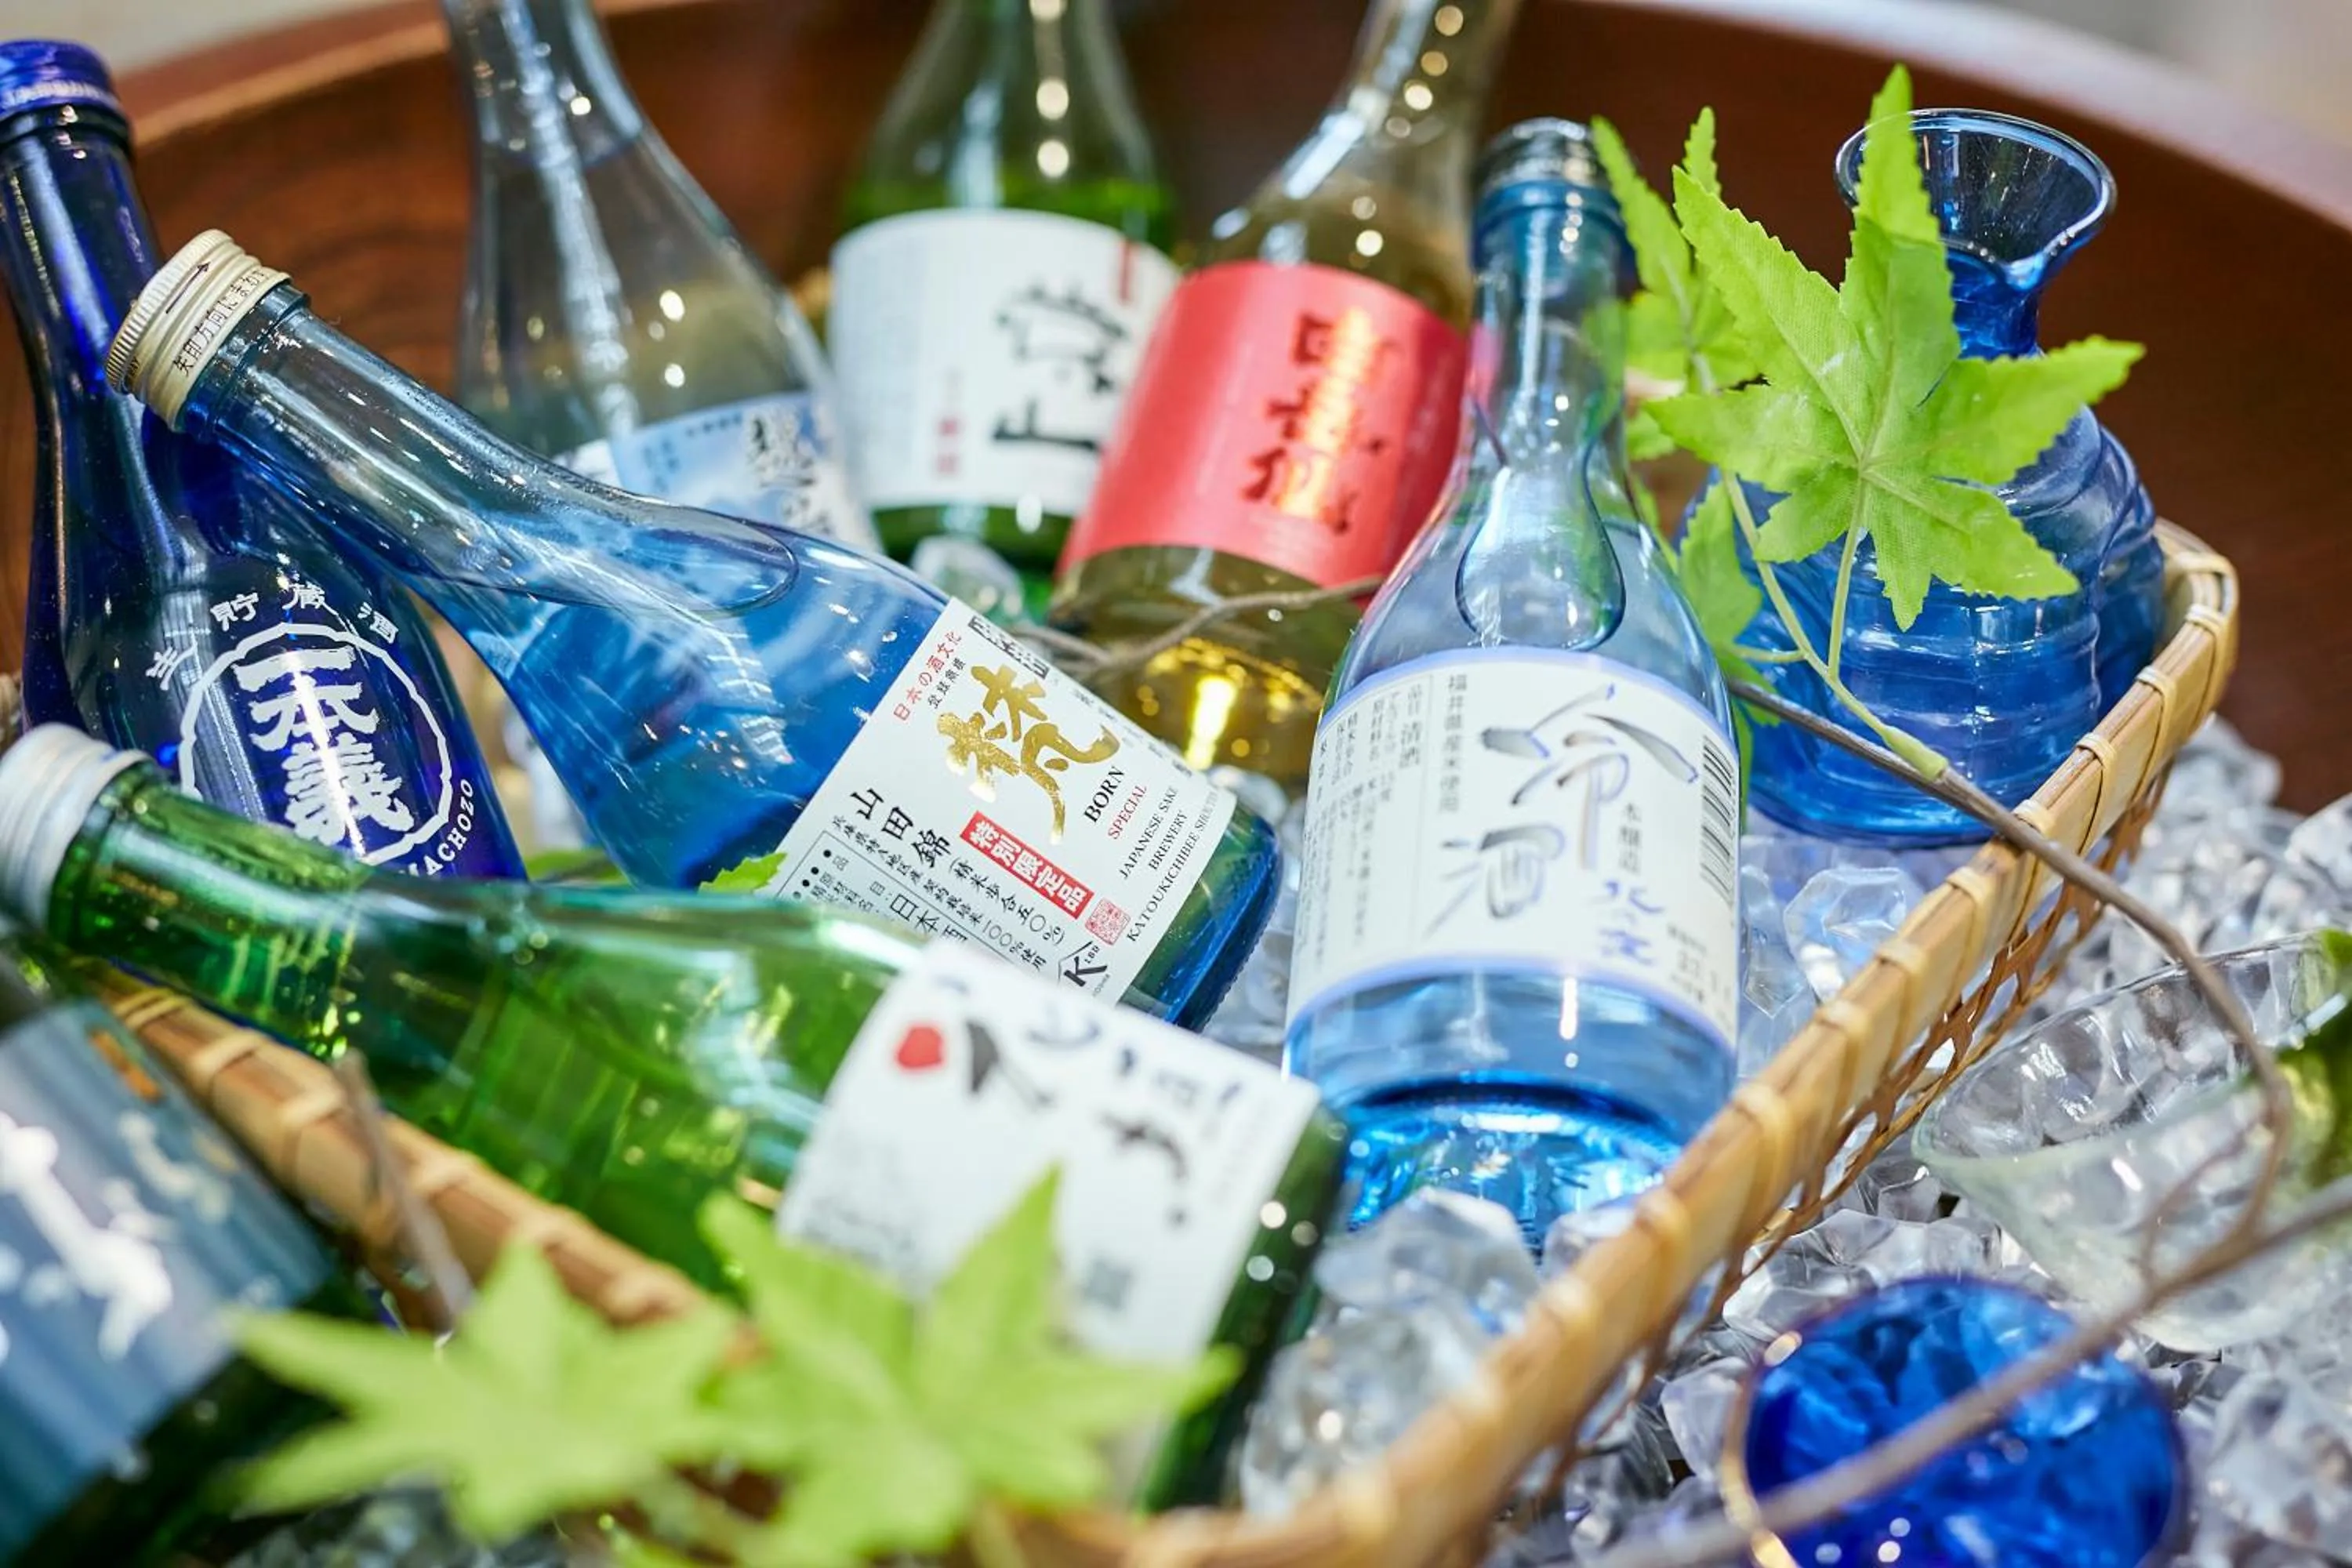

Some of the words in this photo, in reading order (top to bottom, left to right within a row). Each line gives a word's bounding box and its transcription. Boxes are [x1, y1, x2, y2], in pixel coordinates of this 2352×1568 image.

[893, 631, 962, 721] 日本の酒文化
[935, 664, 1121, 845] 梵
[1083, 766, 1124, 823] BORN
[849, 788, 951, 869] 山田錦
[1107, 785, 1147, 840] SPECIAL
[1119, 813, 1164, 880] JAPANESE
[1158, 787, 1178, 813] SAKE
[1147, 810, 1188, 871] BREWERY
[970, 820, 1087, 913] 特別限定品
[1126, 831, 1200, 942] KATOUKICHIBEE
